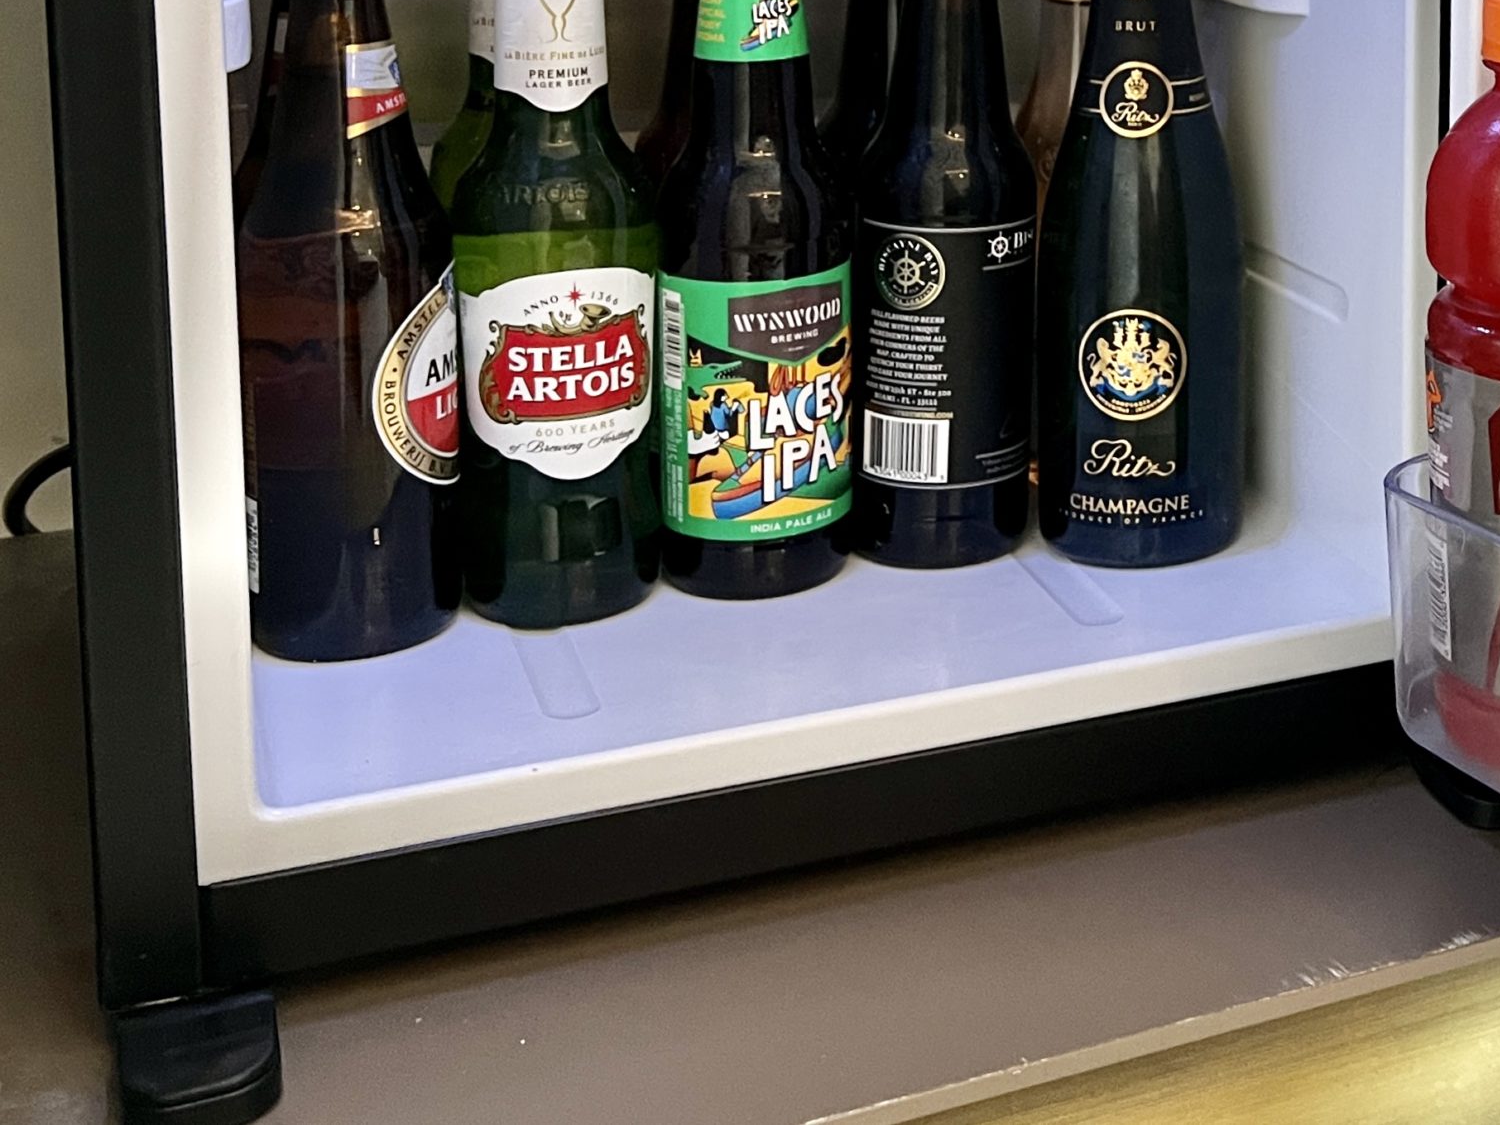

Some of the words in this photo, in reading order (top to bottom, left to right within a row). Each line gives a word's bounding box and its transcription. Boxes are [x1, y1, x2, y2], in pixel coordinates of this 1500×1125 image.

[759, 15, 790, 44] IPA
[1115, 20, 1157, 32] BRUT
[550, 51, 575, 61] FINE
[529, 66, 589, 79] PREMIUM
[525, 80, 562, 89] LAGER
[567, 77, 592, 88] BEER
[1111, 101, 1160, 124] Ritz
[522, 295, 560, 316] ANNO
[590, 290, 620, 306] 1366
[733, 297, 841, 333] WYNWOOD
[920, 316, 946, 324] BEERS
[396, 299, 442, 360] AMSTEL
[770, 328, 819, 344] BREWING
[910, 325, 941, 335] UNIQUE
[910, 334, 932, 342] FROM
[932, 335, 947, 343] ALL
[507, 334, 634, 373] STELLA
[890, 351, 923, 361] CRAFTED
[924, 354, 936, 362] TO
[893, 370, 913, 379] YOUR
[913, 373, 949, 381] JOURNEY
[915, 363, 943, 371] THIRST
[506, 361, 636, 403] ARTOIS
[901, 396, 910, 404] FL
[748, 372, 845, 451] LACES
[382, 379, 425, 467] BROUWERIJ
[535, 427, 564, 438] 600
[570, 418, 616, 435] YEARS
[506, 442, 526, 455] of
[526, 439, 584, 455] Brewing
[762, 424, 838, 503] IPA
[1083, 438, 1176, 477] Ritz
[1069, 493, 1190, 515] CHAMPAGNE
[750, 521, 782, 534] INDIA
[785, 514, 813, 529] PALE
[816, 507, 833, 522] ALE
[1123, 517, 1140, 525] OF
[1152, 509, 1204, 524] FRANCE
